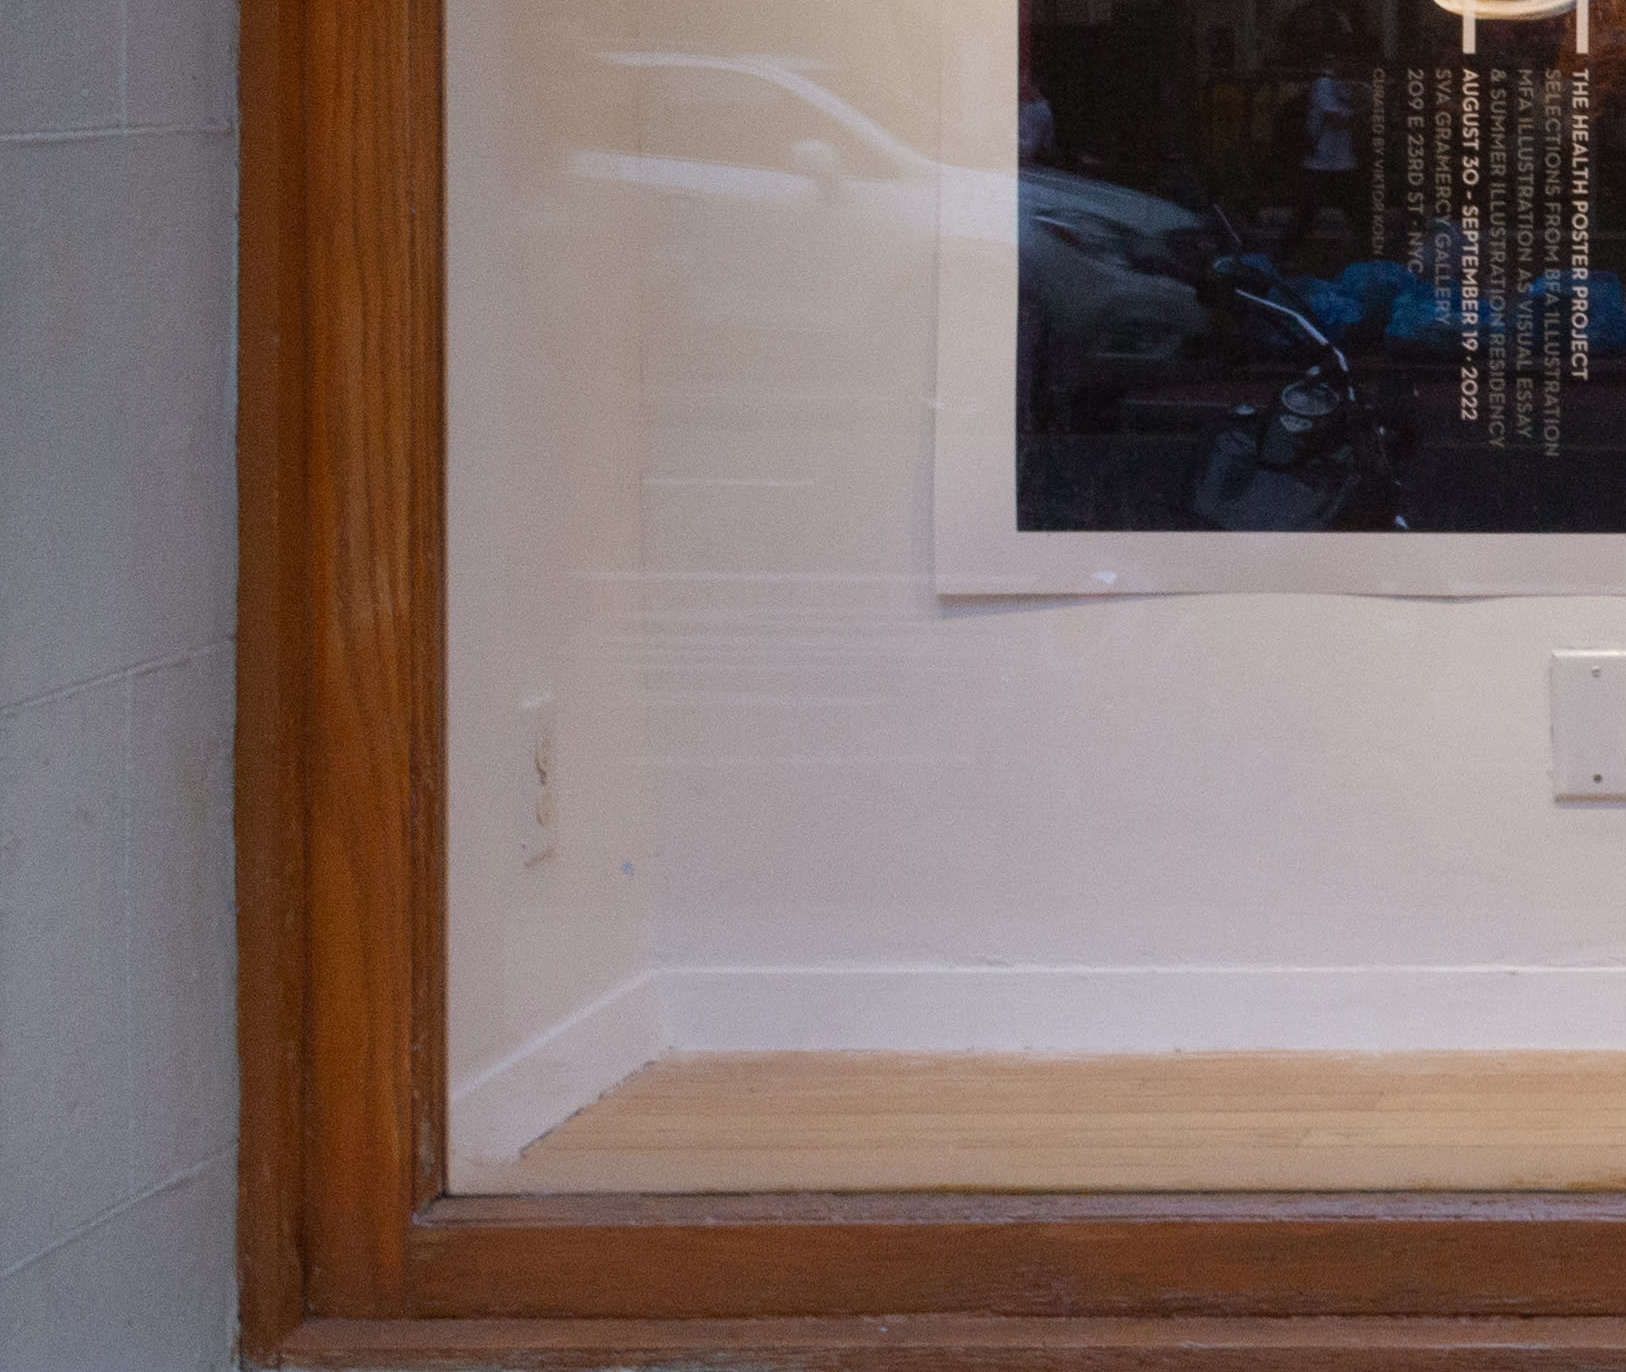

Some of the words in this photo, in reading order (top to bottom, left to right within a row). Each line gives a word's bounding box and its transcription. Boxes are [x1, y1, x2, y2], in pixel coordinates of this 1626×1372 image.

[1372, 68, 1384, 134] CURATED
[1407, 68, 1424, 110] 209
[1434, 68, 1452, 105] SVA
[1489, 68, 1507, 82] &
[1516, 69, 1533, 111] MFA
[1571, 68, 1589, 109] THE
[1407, 116, 1424, 128] E
[1460, 68, 1479, 151] AUGUST
[1489, 88, 1507, 176] SUMMER
[1544, 68, 1561, 196] SELECTIONS
[1372, 137, 1384, 155] BY
[1407, 133, 1424, 186] 23RD
[1434, 111, 1452, 228] GRAMERCY
[1460, 155, 1479, 186] 30
[1571, 115, 1589, 194] HEALTH
[1372, 159, 1384, 213] VIKTOR
[1407, 192, 1424, 215] ST
[1516, 118, 1533, 262] ILLUSTRATION
[1407, 231, 1424, 275] NYC
[1489, 182, 1507, 327] ILLUSTRATION
[1544, 202, 1561, 262] FROM
[1571, 200, 1589, 280] POSTER
[1434, 233, 1452, 325] GALLERY
[1460, 205, 1479, 325] SEPTEMBER
[1516, 268, 1533, 294] AS
[1544, 268, 1561, 306] BFA
[1460, 330, 1479, 351] 19
[1516, 300, 1533, 371] VISUAL
[1571, 286, 1589, 381] PROJECT
[1460, 366, 1479, 420] 2022
[1489, 333, 1507, 448] RESIDENCY
[1516, 377, 1533, 438] ESSAY
[1544, 312, 1561, 457] ILLUSTRATION
